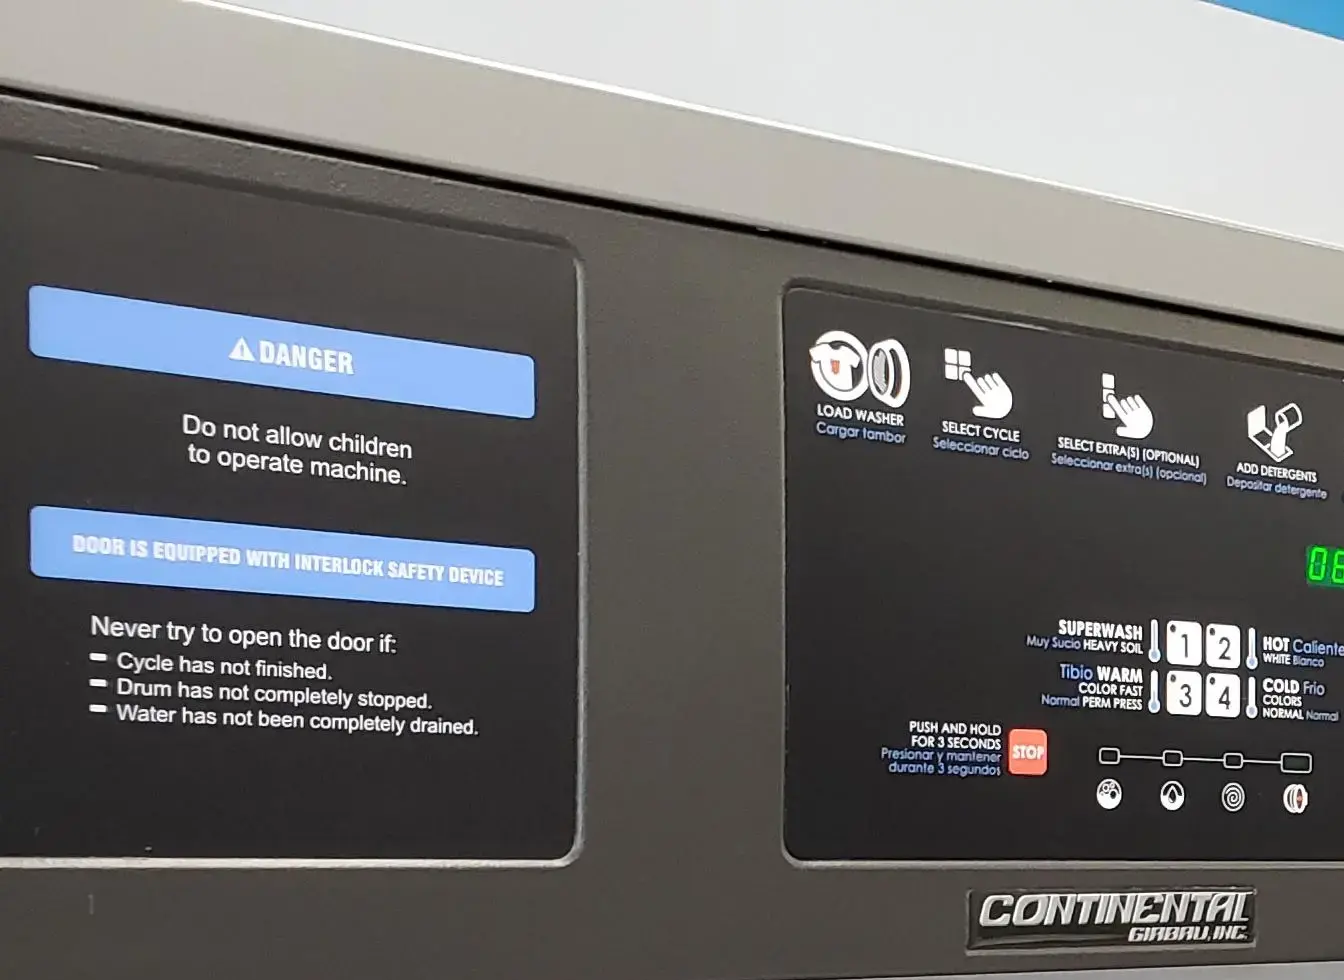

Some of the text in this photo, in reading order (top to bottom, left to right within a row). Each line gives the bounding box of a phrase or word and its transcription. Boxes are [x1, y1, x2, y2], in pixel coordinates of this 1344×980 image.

[260, 340, 353, 375] DANGER
[817, 403, 904, 427] LOAD WASHER
[182, 414, 412, 459] Do not allow children
[816, 421, 907, 444] Cargar tambor
[942, 420, 1020, 443] SELECT CYCLE
[933, 436, 1029, 460] Seleccionar ciclo
[1057, 436, 1200, 469] SELECT EXTRA(S) (OPTIONAL)
[188, 443, 407, 485] to operate machine.
[1051, 452, 1207, 486] Seleccionar extra(s) (opcional)
[1236, 462, 1318, 483] ADD DETERGENTS
[1226, 475, 1328, 500] Depositar detergente
[72, 534, 504, 586] DOOR IS EQUIPPED WITH INTERLOCK SAFETY DEVICE
[91, 615, 397, 654] Never try to open the door if:
[1058, 619, 1143, 641] SUPERWASH
[1026, 634, 1144, 655] Muy Sucio HEAVY SOIL
[1181, 633, 1231, 661] 1 2
[1263, 636, 1289, 652] HOT
[117, 651, 332, 680] Cycle has not finished.
[1263, 653, 1324, 668] WHITE Blanco
[1059, 664, 1143, 683] Tibio WARM
[117, 678, 432, 711] Drum has not completely stopped.
[1079, 682, 1143, 697] COLOR FAST
[1179, 685, 1231, 709] 3 4
[1263, 678, 1299, 694] COLD
[1041, 694, 1143, 711] Normal PERM PRESS
[1263, 694, 1302, 706] COLORS
[117, 704, 479, 736] Water has not been completely drained.
[1263, 708, 1339, 722] NORMAL Normal
[909, 720, 1002, 736] PUSH AND HOLD
[911, 735, 1002, 750] FOR 3 SECONDS
[1012, 744, 1045, 760] STOP
[881, 747, 1002, 762] Presionar y mantener
[889, 762, 1001, 777] durante 3 segundos
[979, 892, 1250, 927] CONTINENTAL
